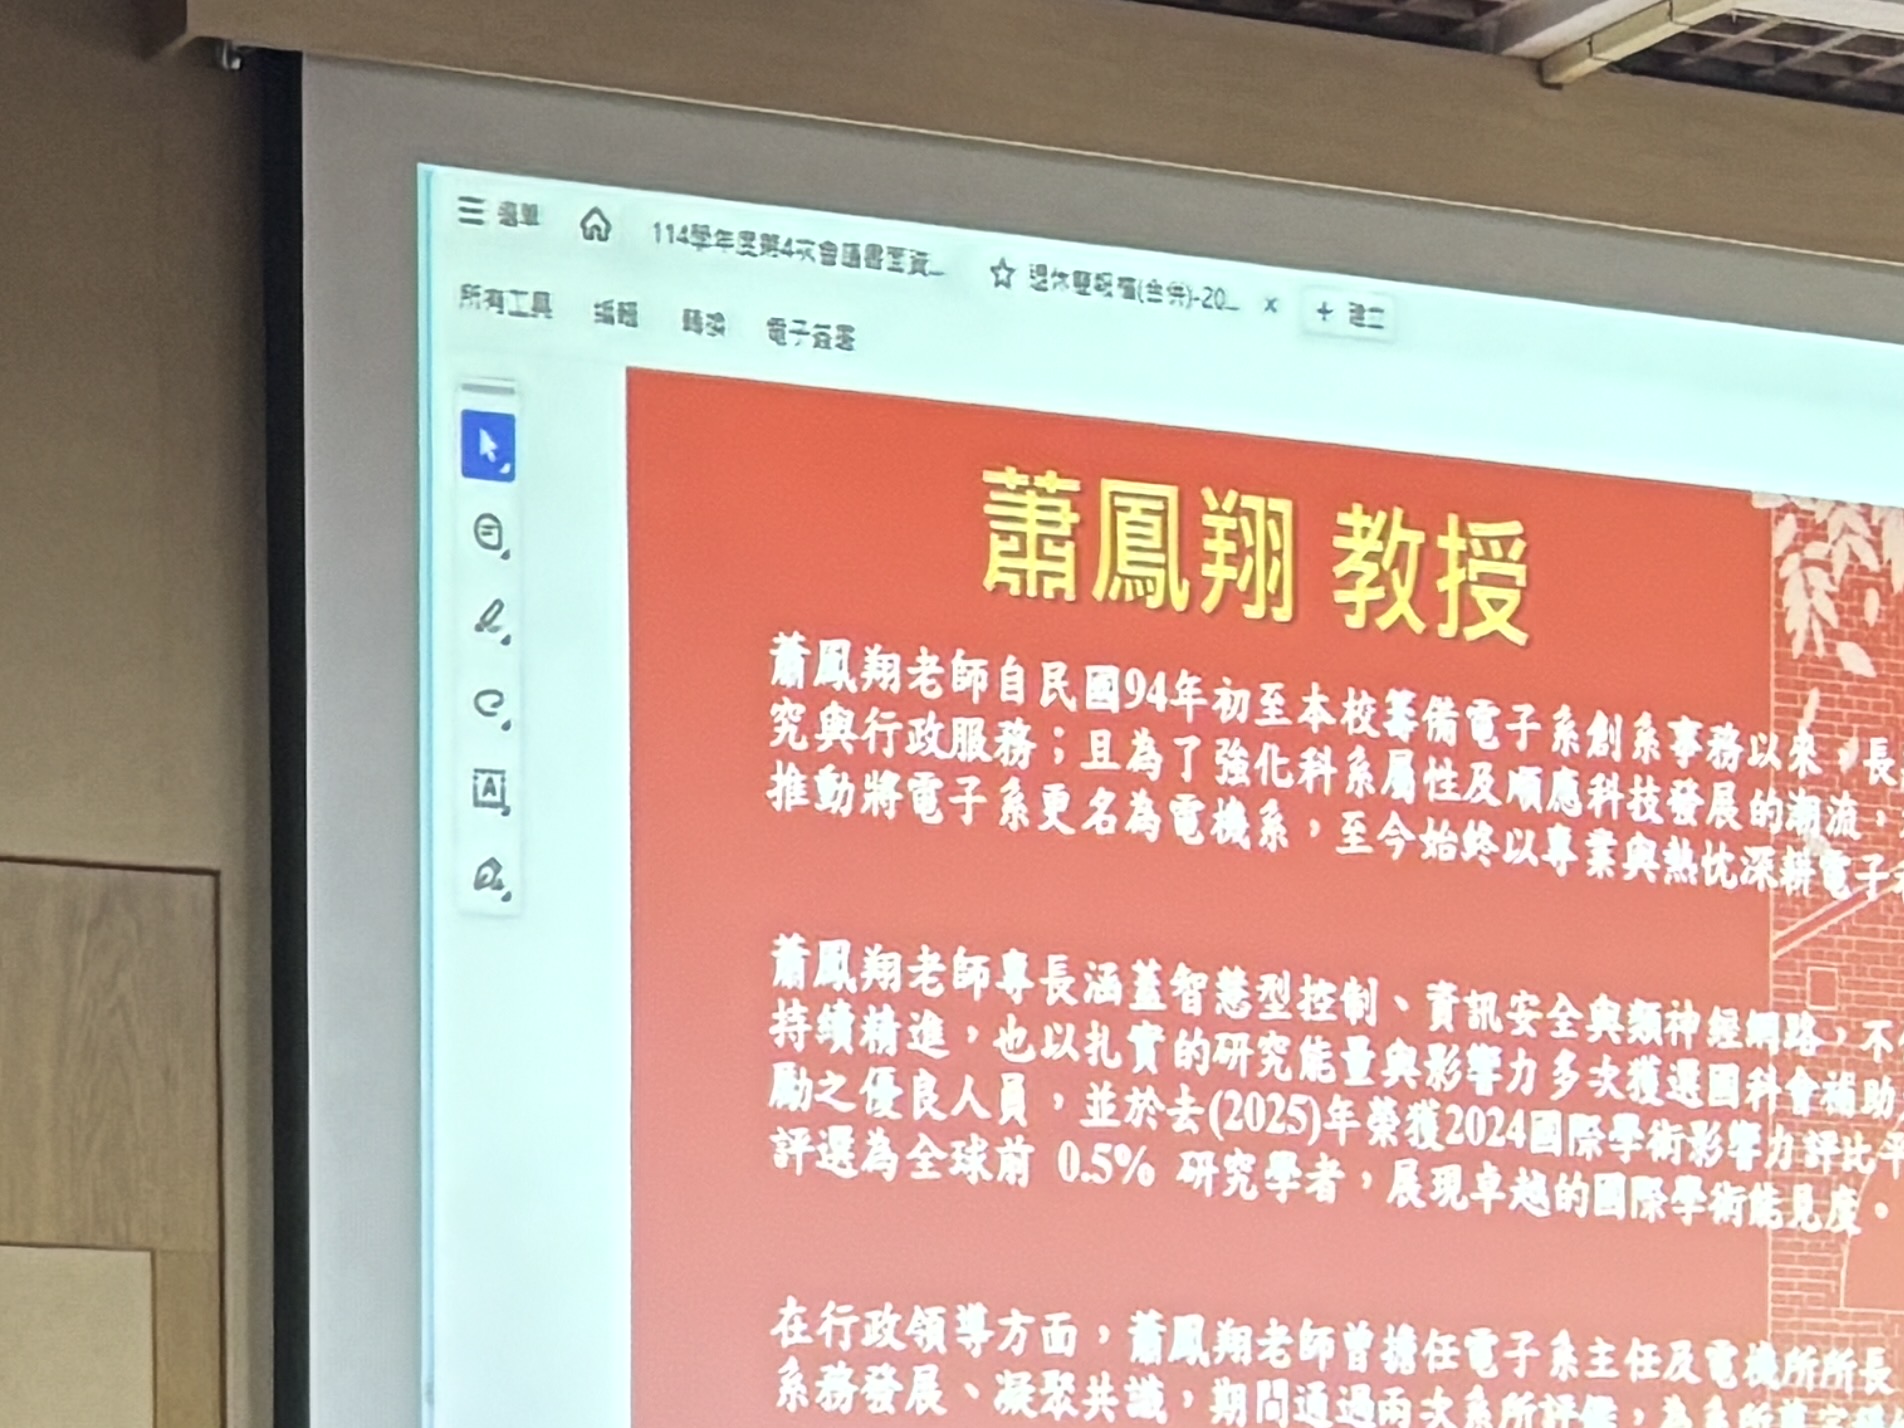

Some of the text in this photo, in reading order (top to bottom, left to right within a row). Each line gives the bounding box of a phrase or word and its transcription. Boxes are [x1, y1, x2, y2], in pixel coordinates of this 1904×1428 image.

[982, 466, 1530, 648] 蕭鳳翔 教授
[769, 1125, 1035, 1188] 評選為全球前
[1057, 1140, 1156, 1187] 0.5%
